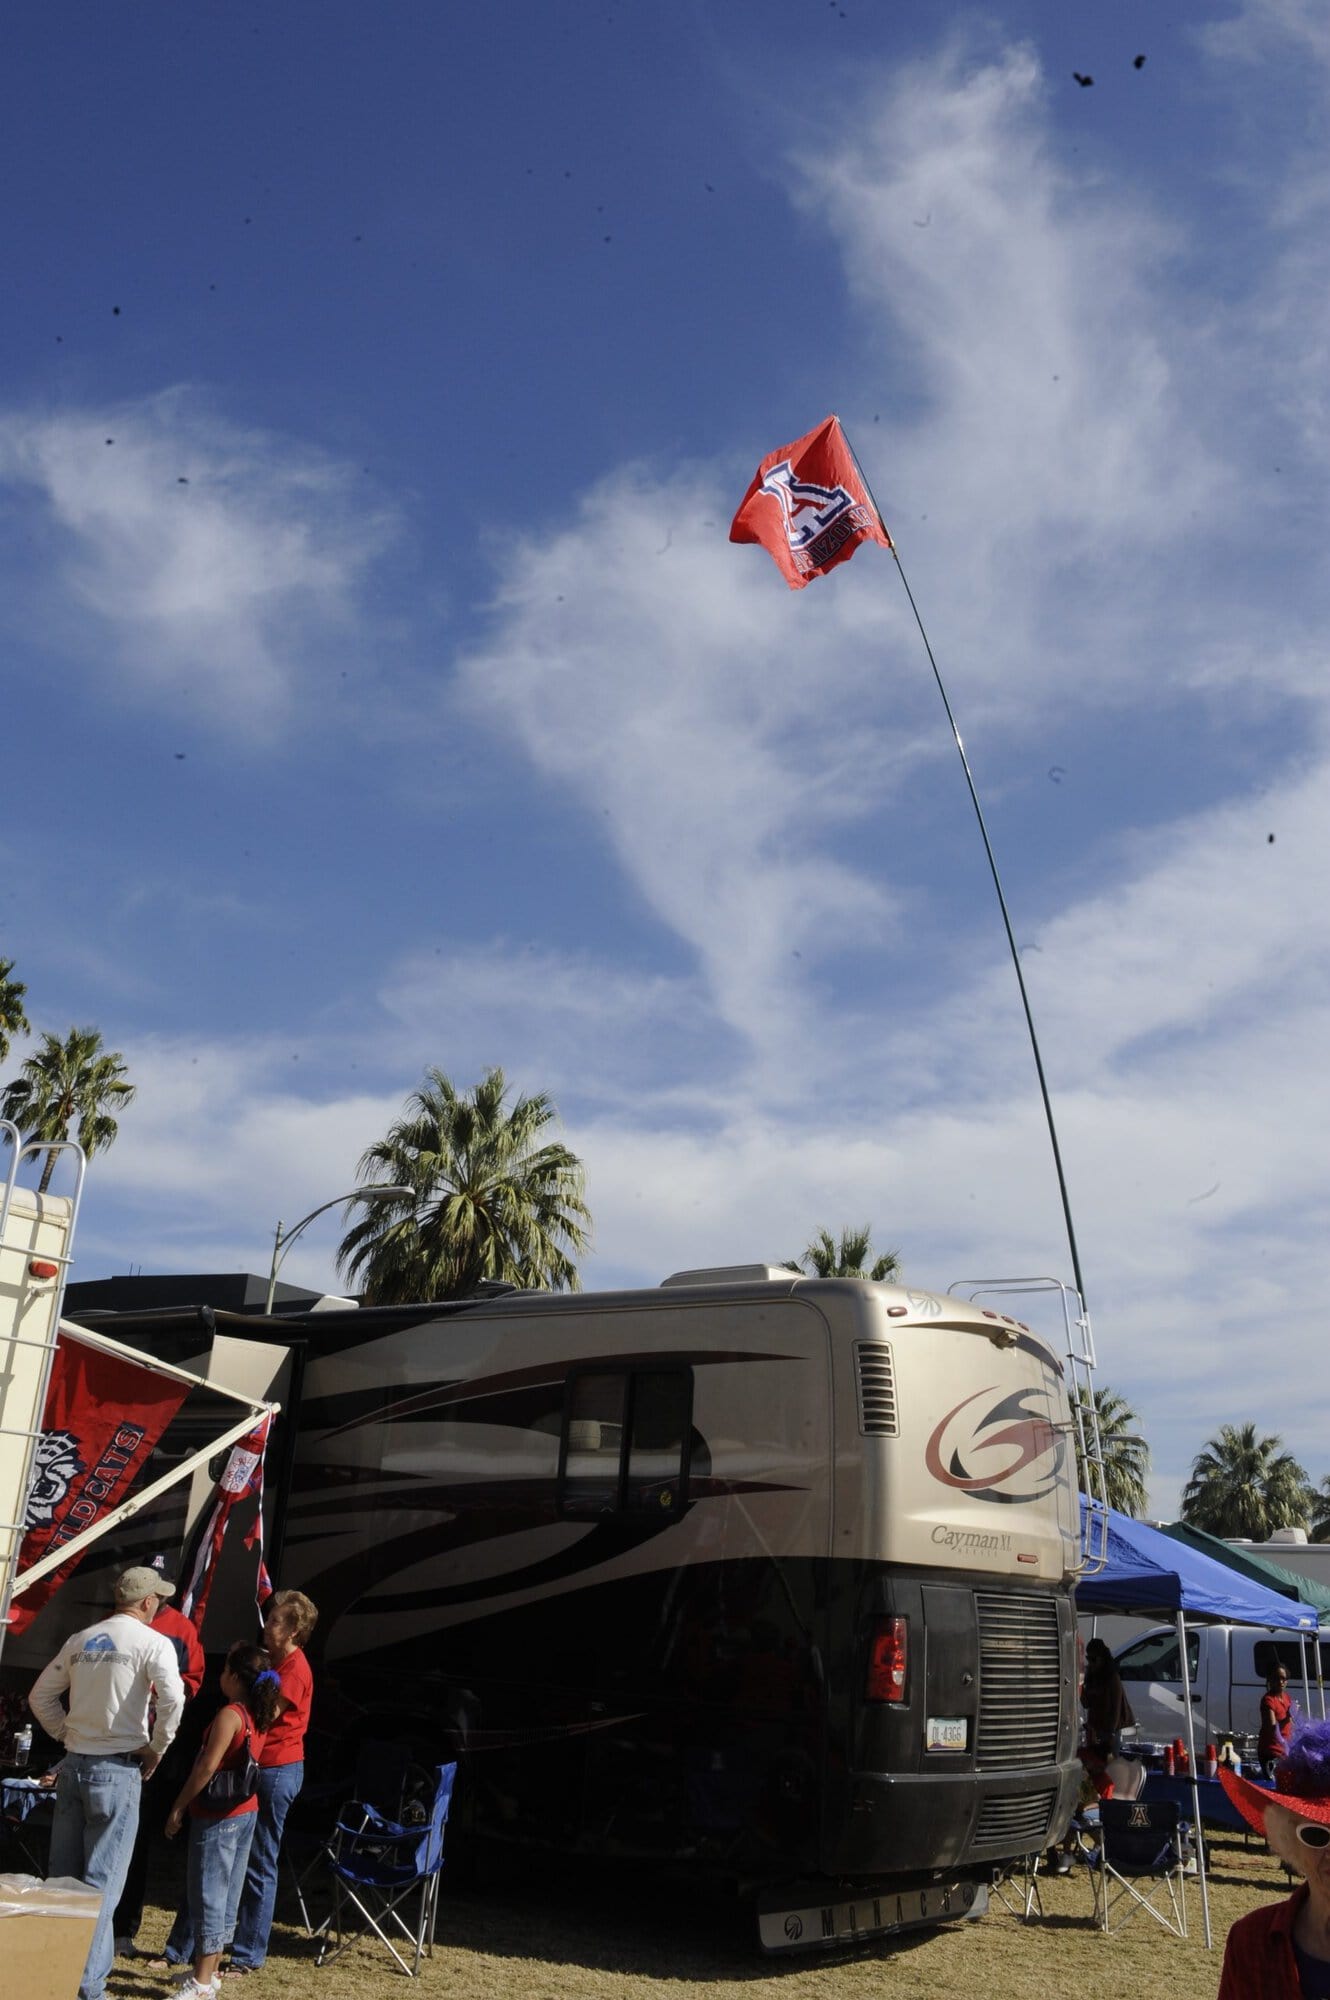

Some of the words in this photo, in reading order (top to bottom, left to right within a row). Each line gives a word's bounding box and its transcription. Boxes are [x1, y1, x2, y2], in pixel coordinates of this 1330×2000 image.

[931, 1525, 999, 1551] Cayman
[1127, 1803, 1151, 1828] A
[821, 1887, 951, 1937] MONACO
